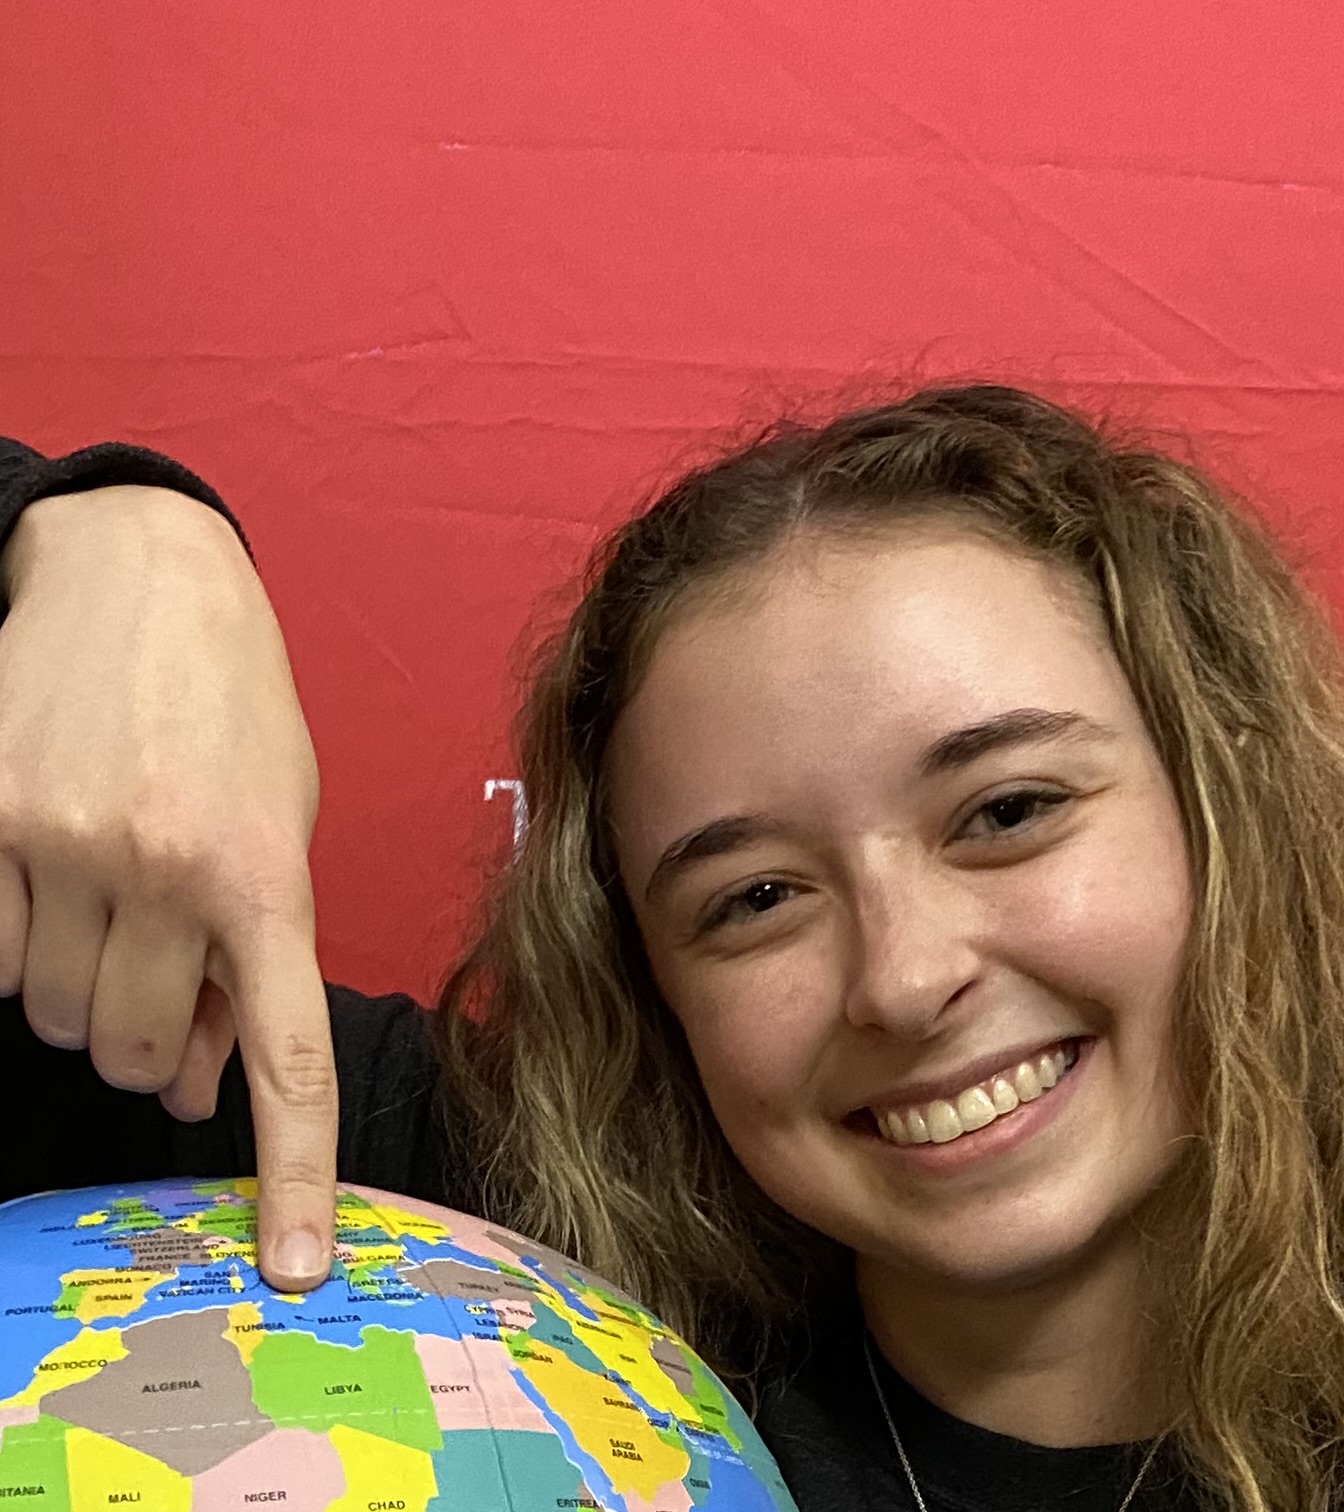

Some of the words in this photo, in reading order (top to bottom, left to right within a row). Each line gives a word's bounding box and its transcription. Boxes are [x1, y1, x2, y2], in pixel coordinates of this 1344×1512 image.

[68, 1277, 133, 1288] ANDORRA
[95, 1294, 133, 1302] SPAIN
[158, 1288, 215, 1298] VATICAN
[347, 1292, 425, 1303] MACEDONIA
[5, 1303, 75, 1317] PORTUGAL
[318, 1314, 362, 1325] MALTA
[234, 1321, 286, 1333] TUNISIA
[38, 1358, 108, 1372] MOROCCO
[141, 1379, 202, 1394] ALGERIA
[324, 1383, 363, 1396] LIBYA
[430, 1384, 471, 1394] EGYPT
[108, 1490, 142, 1503] MALI
[244, 1489, 288, 1503] NIGER
[368, 1499, 406, 1512] CHAD
[556, 1499, 599, 1509] ERITREA
